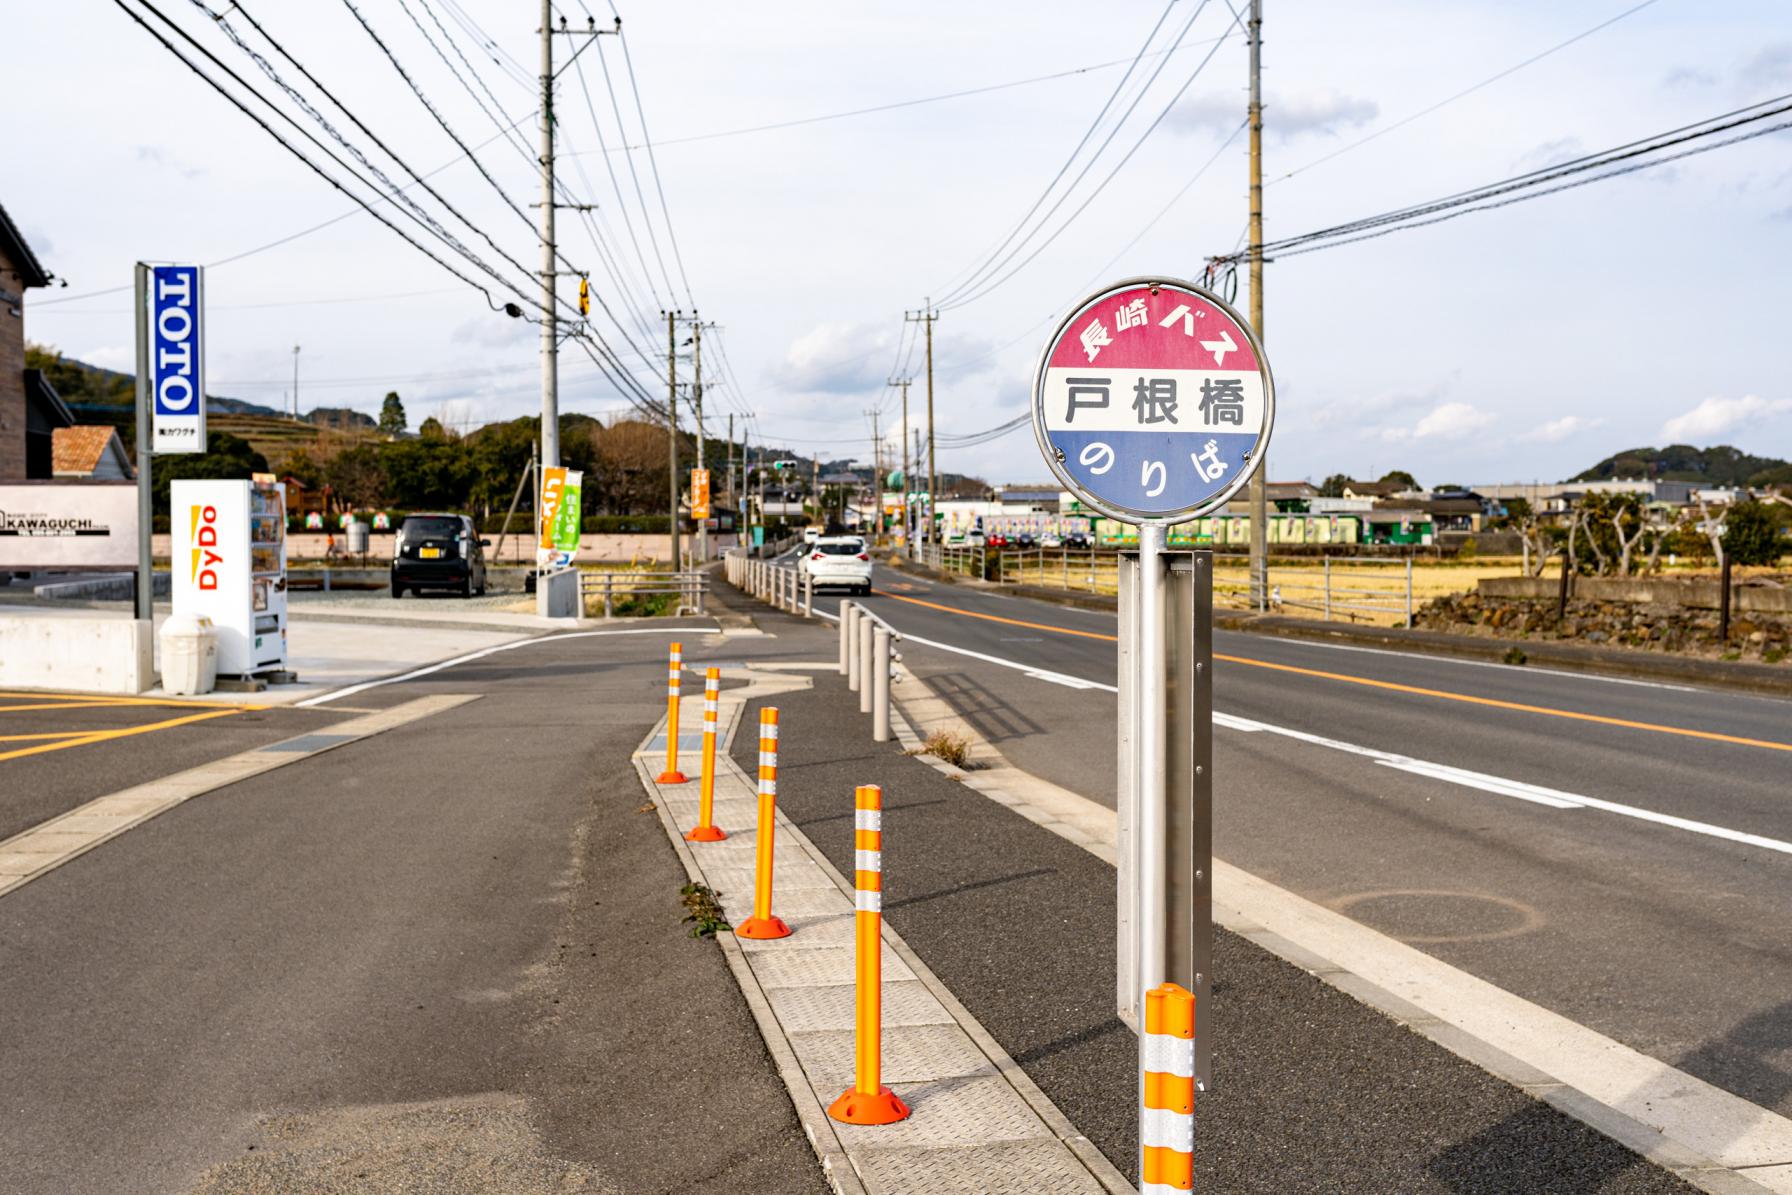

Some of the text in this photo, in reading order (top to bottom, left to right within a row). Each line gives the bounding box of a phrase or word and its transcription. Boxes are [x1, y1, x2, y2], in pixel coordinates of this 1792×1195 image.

[158, 272, 193, 411] TOTO
[1079, 297, 1238, 367] 長崎バス
[1065, 376, 1245, 426] 戸根橋
[1079, 439, 1228, 498] のりば
[7, 519, 92, 529] KAWAGUCHI
[199, 505, 223, 591] DyDo
